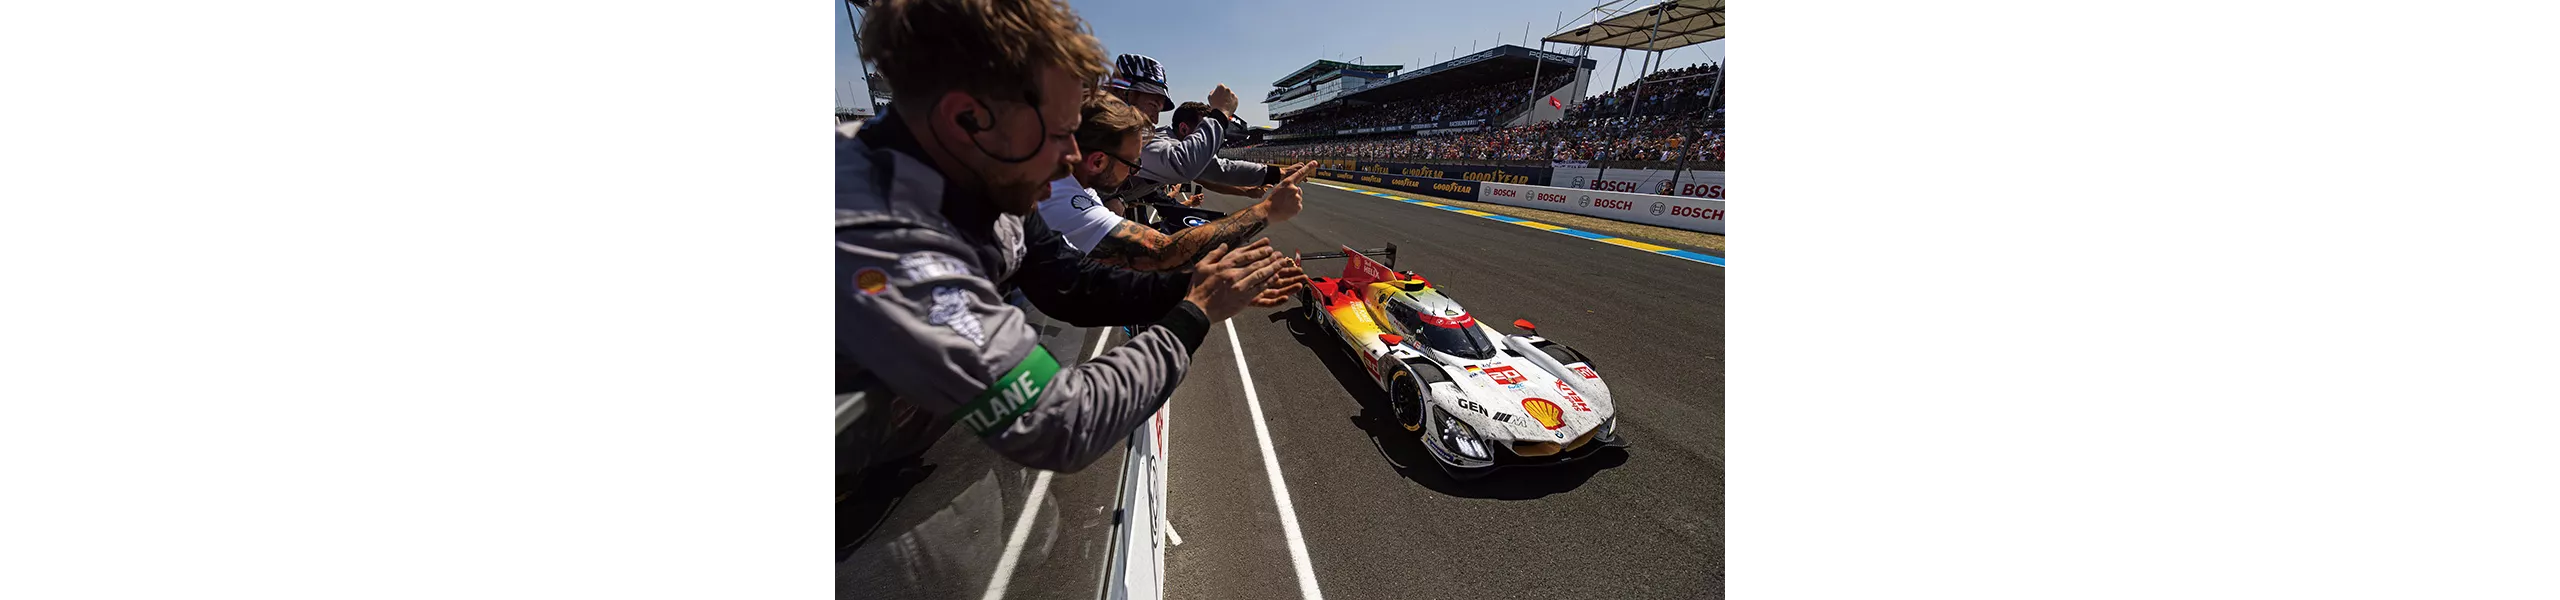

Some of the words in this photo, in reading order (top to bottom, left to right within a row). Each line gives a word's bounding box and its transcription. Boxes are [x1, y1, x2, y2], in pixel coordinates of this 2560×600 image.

[1447, 51, 1493, 68] PORSCHE
[1529, 50, 1575, 64] PORSCHE
[1392, 178, 1420, 188] GOODYEAR
[1433, 182, 1472, 194] GOODYEAR
[1590, 179, 1637, 193] BOSCH
[1493, 188, 1517, 198] BOSCH
[1537, 193, 1567, 204] BOSCH
[1594, 198, 1633, 211] BOSCH
[1671, 205, 1725, 221] BOSCH
[1363, 265, 1380, 280] HELIX
[1487, 369, 1521, 382] 20
[1457, 398, 1489, 418] GEN
